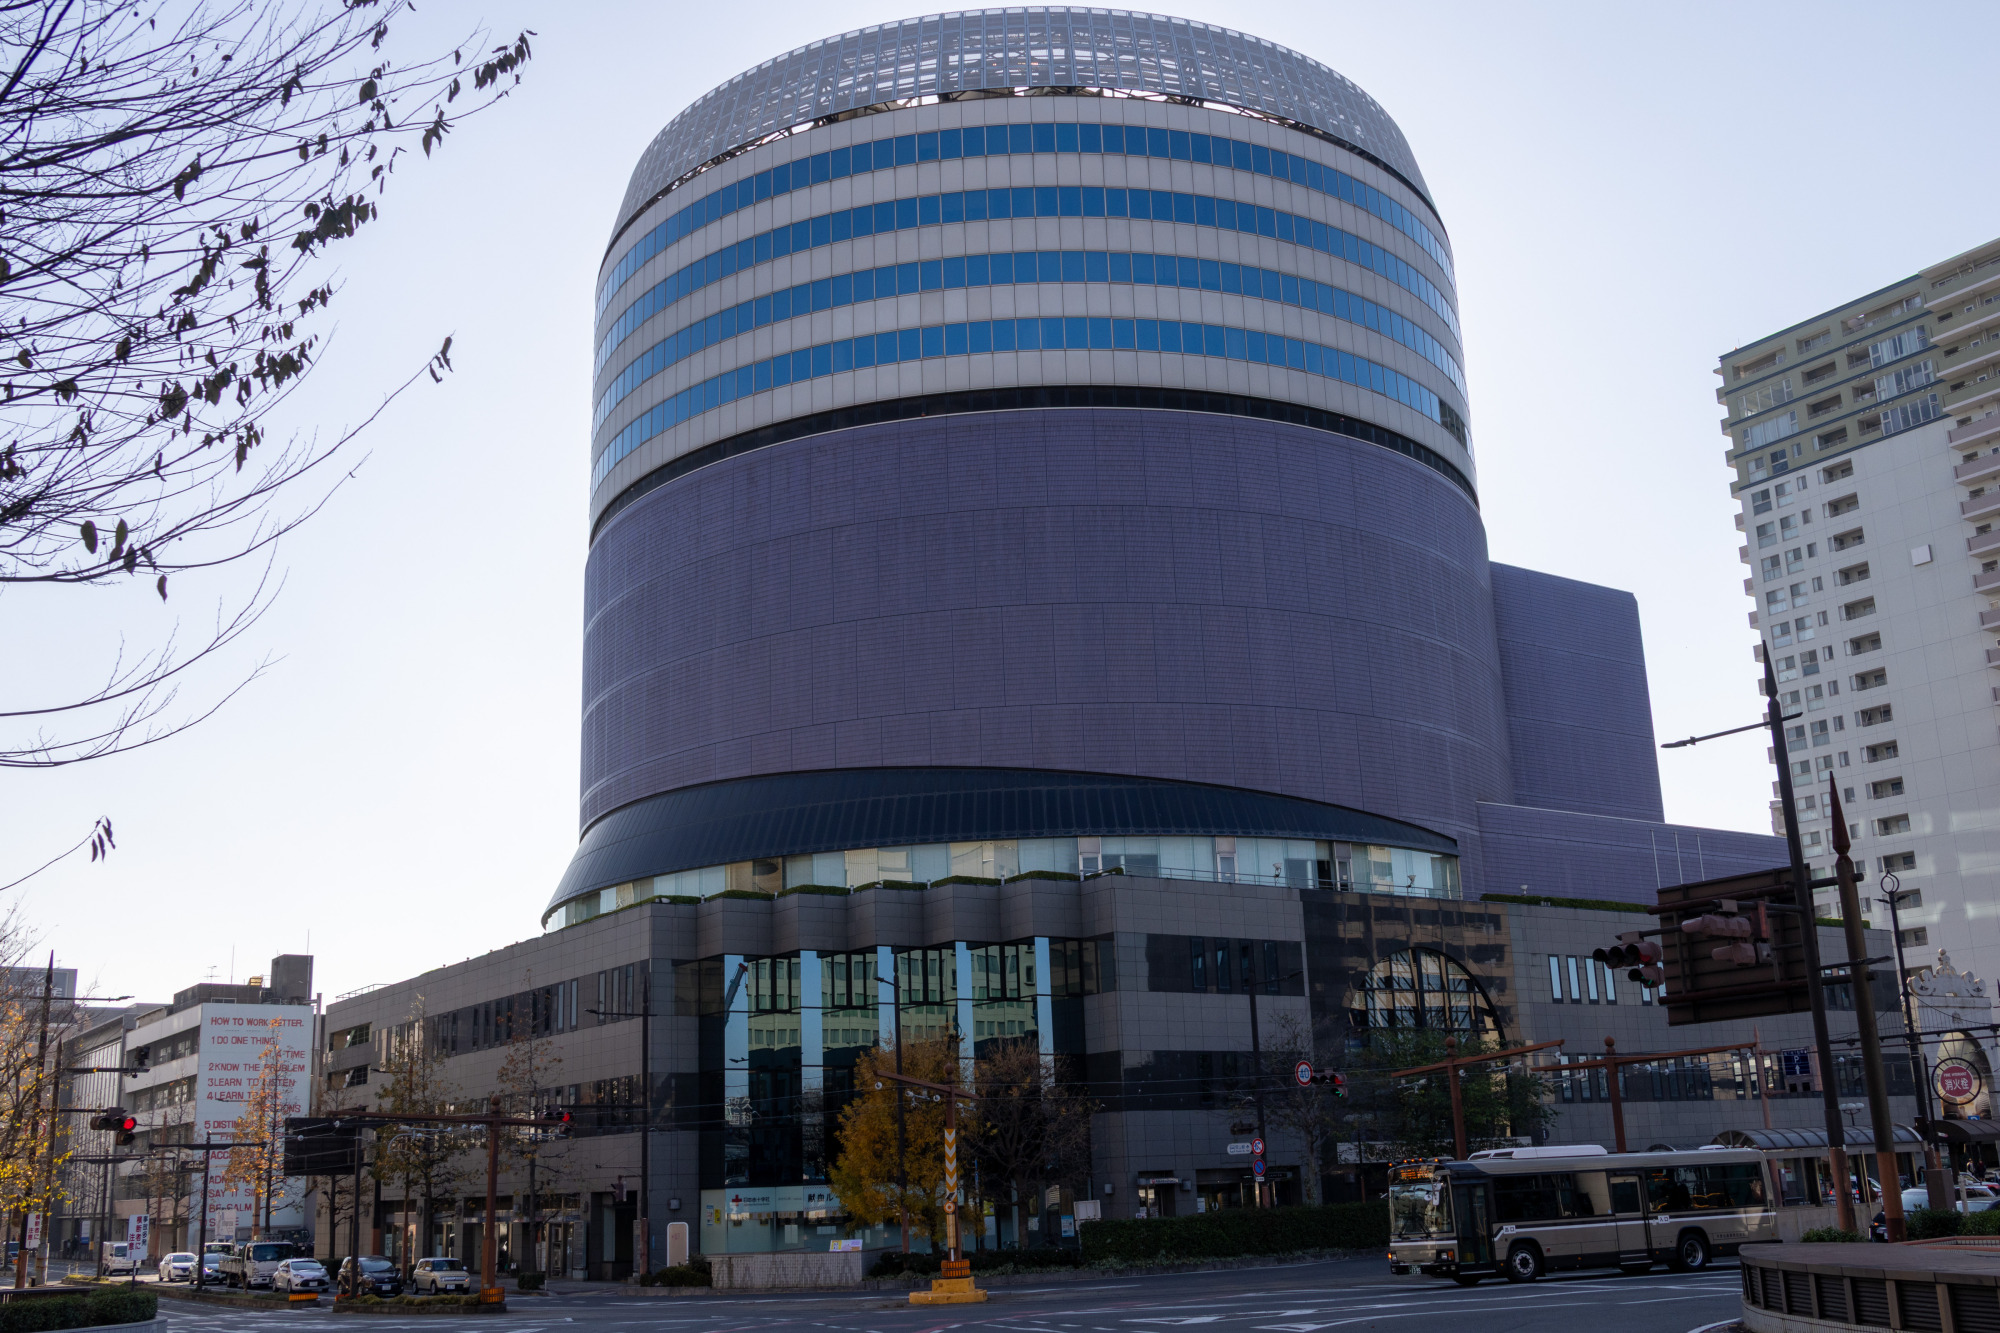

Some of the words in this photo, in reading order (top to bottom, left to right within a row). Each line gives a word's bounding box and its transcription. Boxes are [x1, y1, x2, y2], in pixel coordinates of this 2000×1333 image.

[210, 1017, 230, 1026] HOW
[232, 1017, 244, 1026] TO
[246, 1018, 269, 1027] WORK
[231, 1036, 249, 1045] ONE
[251, 1036, 276, 1045] THING
[283, 1050, 306, 1059] TIME
[243, 1063, 260, 1072] THE
[1300, 1067, 1310, 1078] 40
[246, 1078, 259, 1087] TO
[1945, 1078, 1970, 1091] 消火栓
[208, 1189, 226, 1198] SAY
